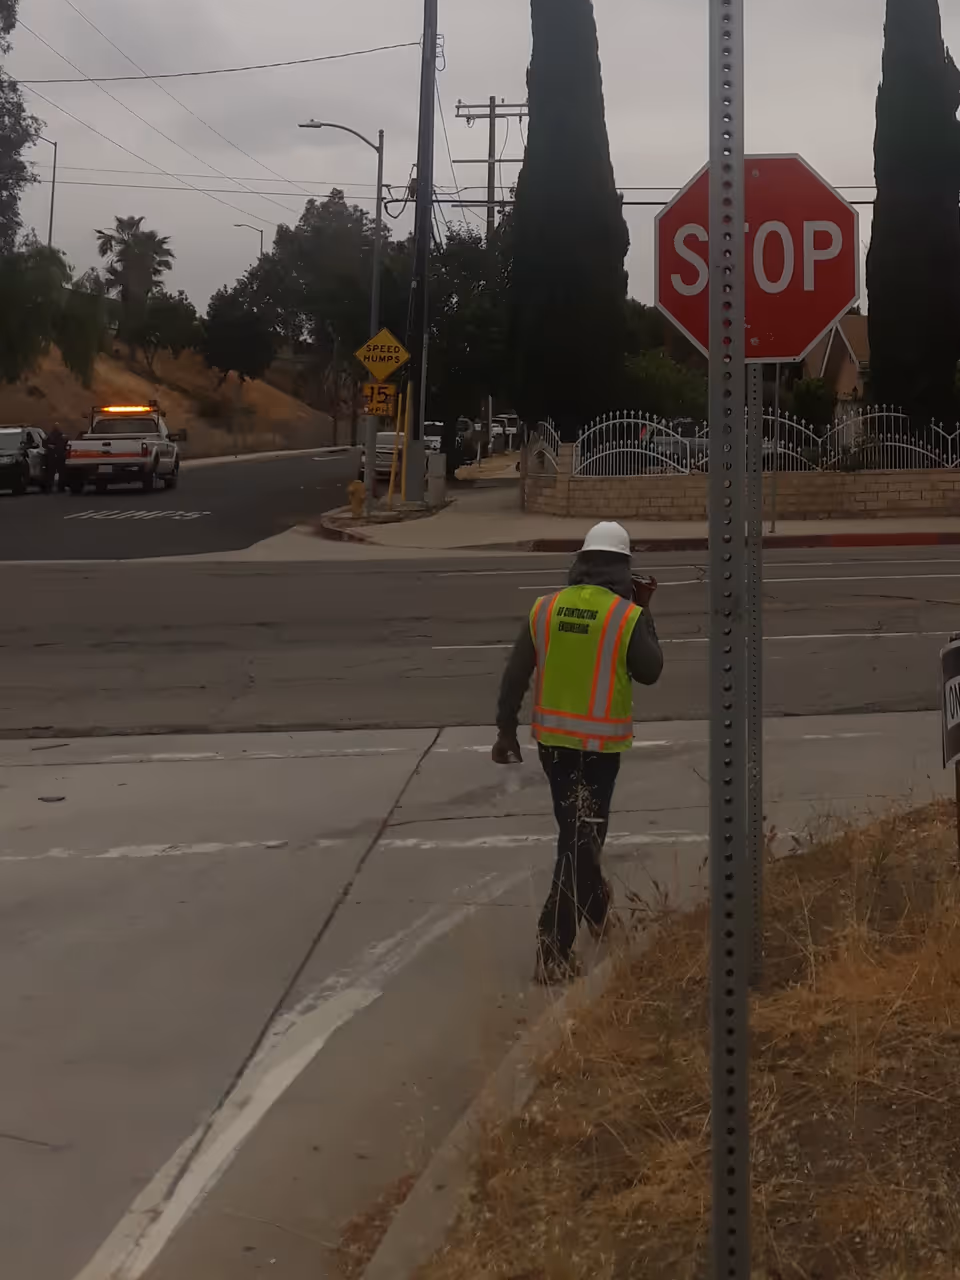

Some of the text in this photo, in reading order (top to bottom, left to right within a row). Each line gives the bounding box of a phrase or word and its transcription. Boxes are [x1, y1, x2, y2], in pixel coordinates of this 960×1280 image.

[670, 220, 843, 296] SOP
[366, 344, 400, 353] SPEED
[363, 354, 400, 363] HUMPS
[369, 386, 389, 403] 15
